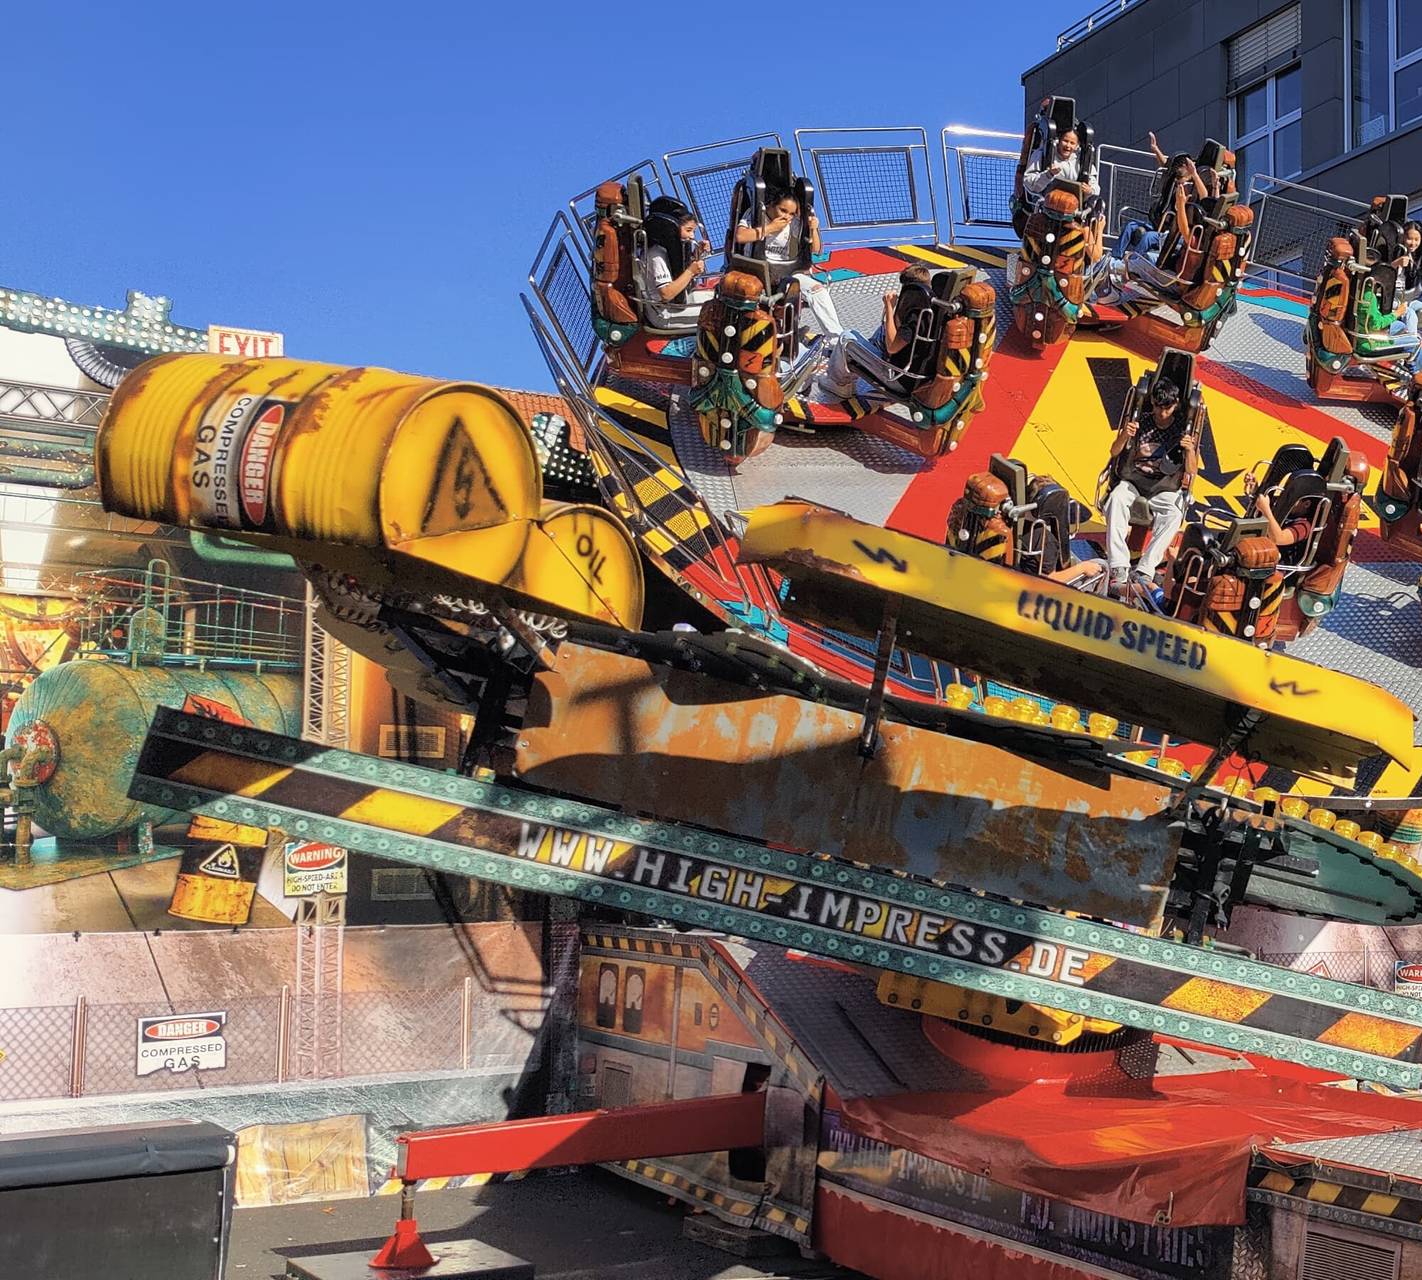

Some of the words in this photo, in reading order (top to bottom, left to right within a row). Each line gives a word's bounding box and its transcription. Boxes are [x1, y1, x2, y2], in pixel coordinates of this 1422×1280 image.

[218, 332, 273, 357] EXIT
[192, 425, 217, 489] GAS
[245, 421, 278, 504] DANGER
[576, 533, 607, 586] OIL
[1017, 590, 1115, 641] LIQUID
[1119, 620, 1208, 671] SPEED
[290, 847, 342, 864] WARNING
[302, 883, 314, 891] NOT
[517, 822, 1092, 986] WWW.HIGH-IMPRESS.DE
[158, 1021, 207, 1037] DANGER
[141, 1043, 222, 1058] COMPRESSED
[164, 1055, 200, 1069] GAS
